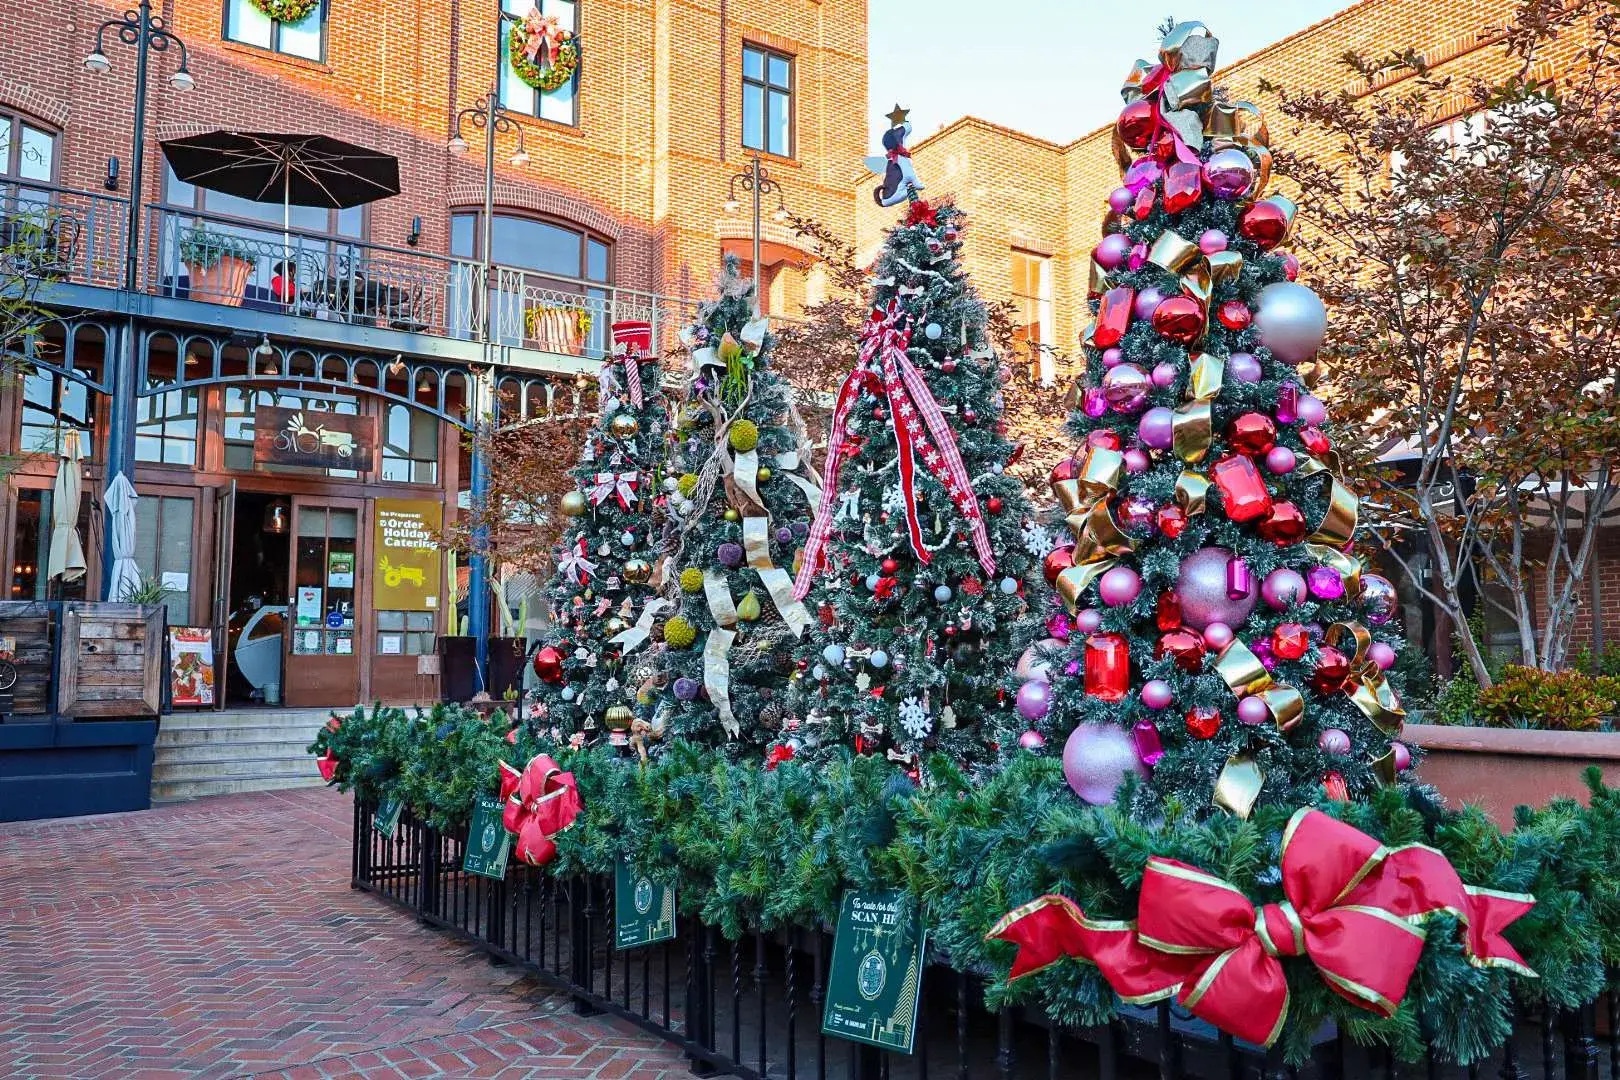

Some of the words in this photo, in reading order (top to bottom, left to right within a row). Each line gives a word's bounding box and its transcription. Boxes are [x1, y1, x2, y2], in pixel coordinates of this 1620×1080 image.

[388, 519, 424, 529] Order
[383, 528, 430, 541] Holiday
[384, 537, 438, 550] Catering
[851, 911, 878, 923] SCAN
